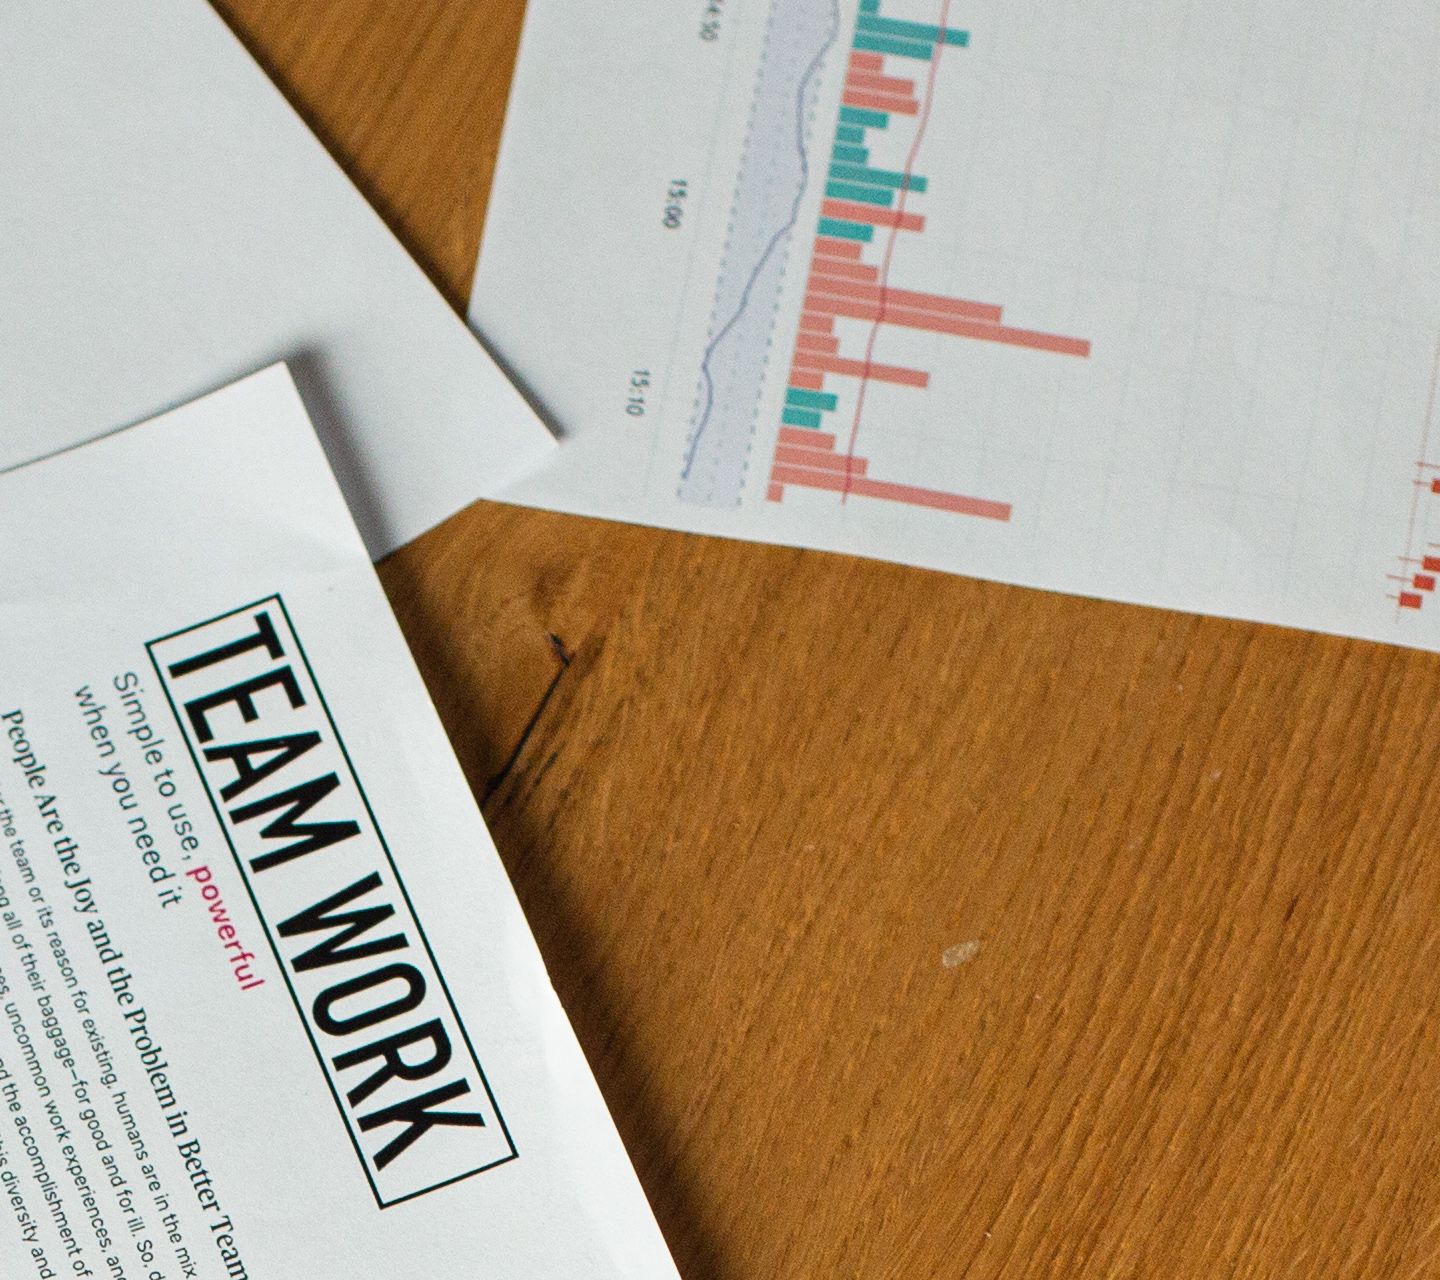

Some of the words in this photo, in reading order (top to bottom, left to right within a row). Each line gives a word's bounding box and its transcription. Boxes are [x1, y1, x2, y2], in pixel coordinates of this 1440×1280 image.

[662, 178, 689, 230] 15:00
[625, 367, 651, 417] 15:10
[0, 708, 46, 789] People
[33, 794, 64, 834] Are
[73, 684, 116, 758] when
[97, 761, 138, 811] you
[126, 816, 177, 884] need
[156, 885, 183, 909] it
[52, 835, 81, 876] the
[112, 671, 165, 765] Simple
[152, 768, 176, 798] to
[166, 802, 199, 860] use,
[184, 864, 266, 991] powerful
[63, 876, 98, 913] Joy
[166, 610, 362, 874] TEAM
[275, 870, 486, 1172] WORK
[85, 918, 124, 965] and
[105, 965, 134, 1006] the
[8, 838, 36, 884] team
[27, 885, 45, 903] or
[36, 906, 54, 929] its
[45, 930, 78, 989] reason
[70, 989, 90, 1014] for
[110, 1090, 149, 1161] humans
[139, 1163, 161, 1192] are
[152, 1192, 169, 1212] in
[161, 1212, 183, 1244] the
[122, 1006, 177, 1110] Problem
[164, 1109, 188, 1138] in
[176, 1137, 221, 1212] Better
